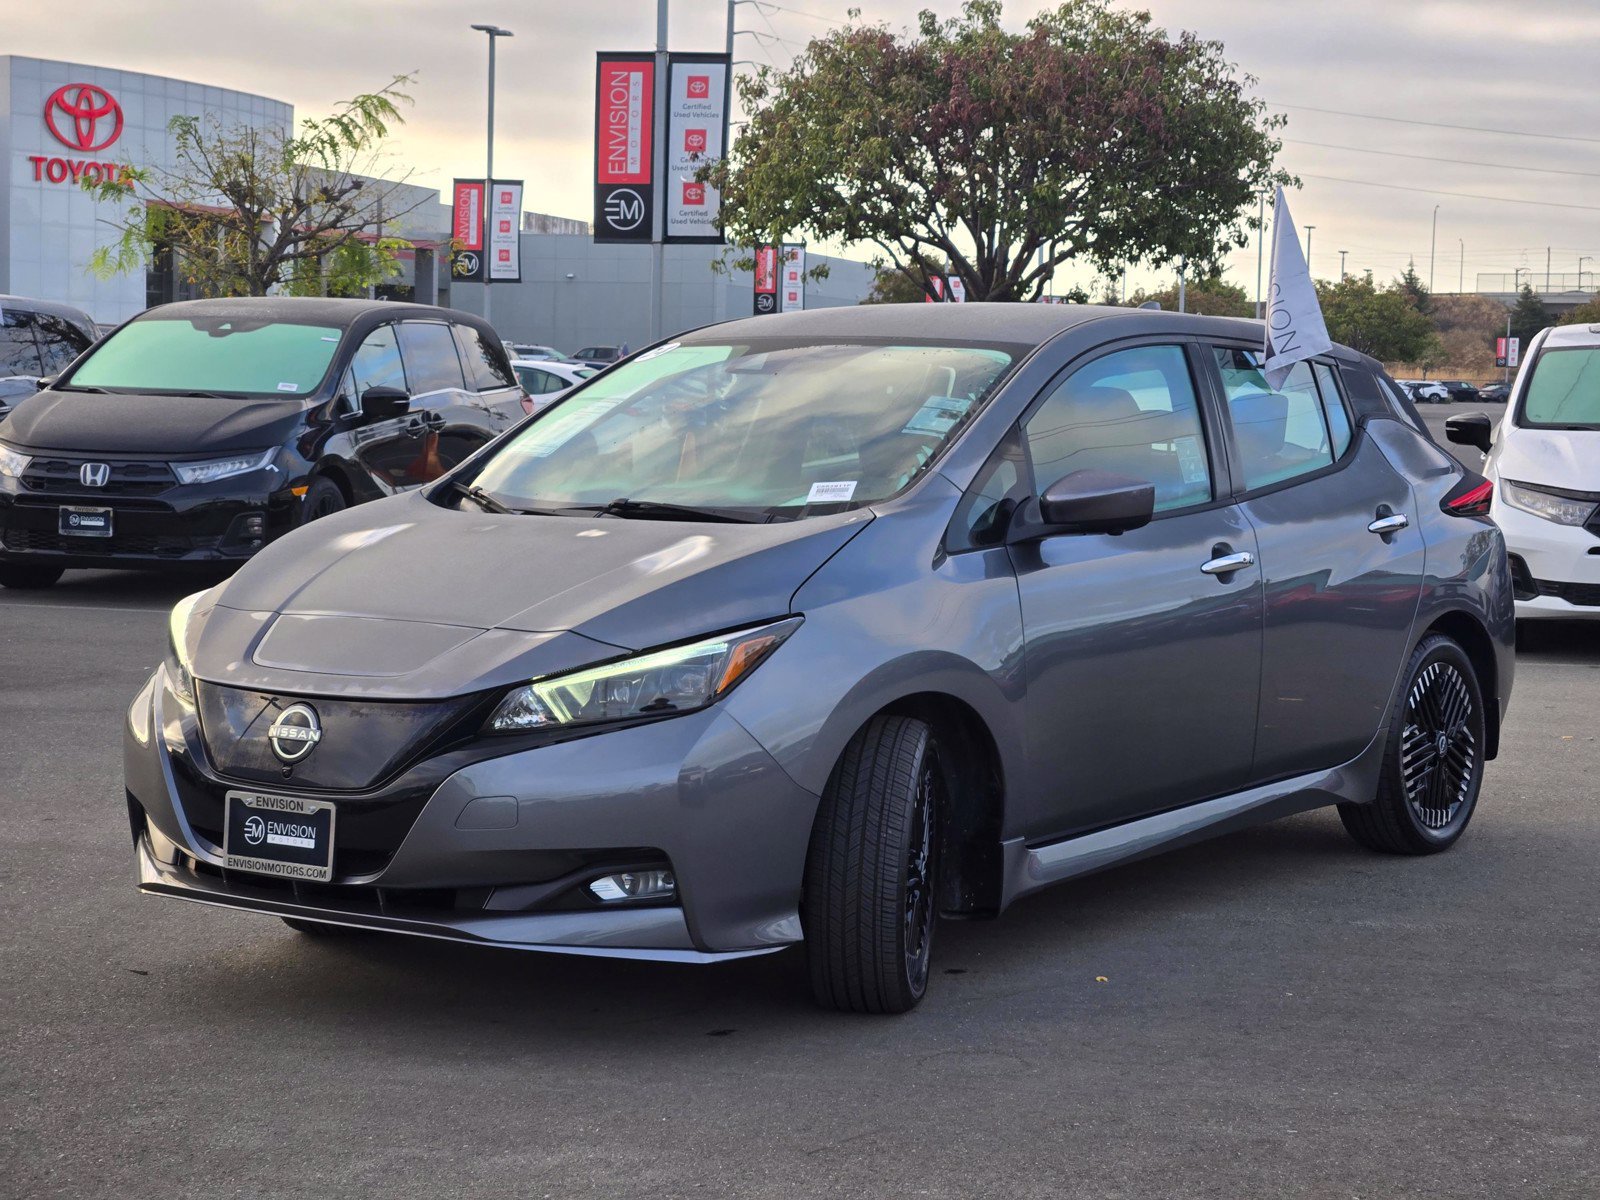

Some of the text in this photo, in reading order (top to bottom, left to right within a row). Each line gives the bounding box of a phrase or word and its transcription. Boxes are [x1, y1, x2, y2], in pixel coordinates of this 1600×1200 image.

[608, 71, 628, 174] ENVISION
[630, 81, 640, 165] MOTORS
[679, 209, 708, 217] Certified
[269, 727, 320, 741] NISSAN
[256, 796, 304, 812] ENVISION
[267, 821, 316, 839] ENVISION
[228, 857, 327, 879] ENVISIONMOTORS.COM
